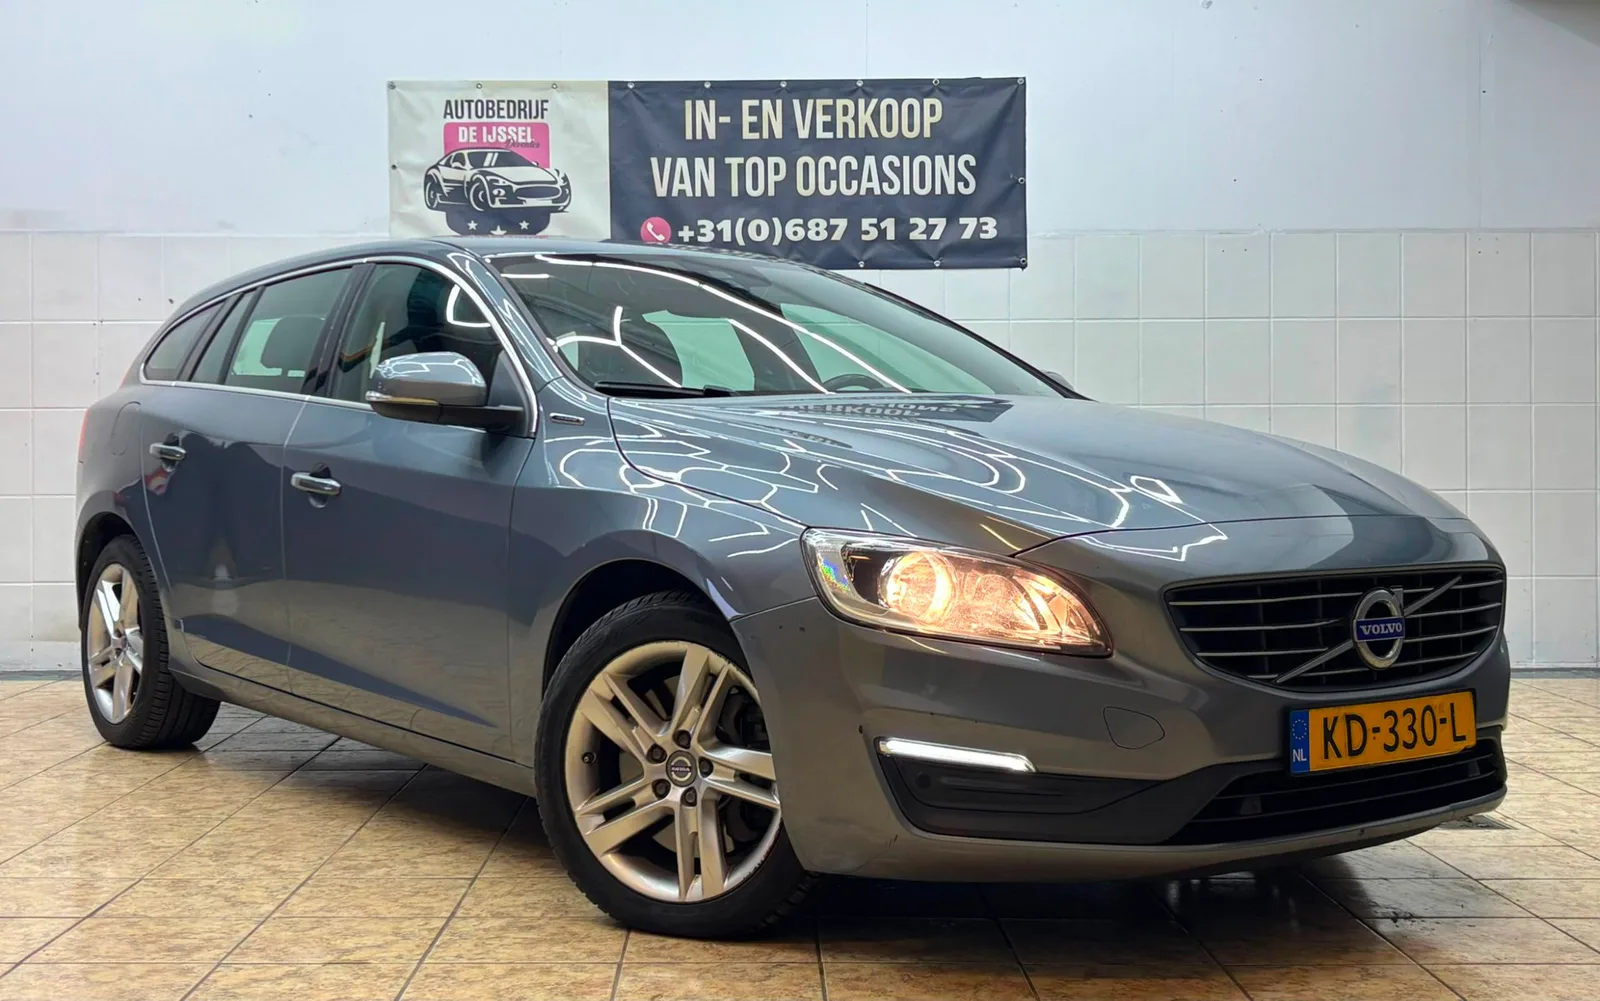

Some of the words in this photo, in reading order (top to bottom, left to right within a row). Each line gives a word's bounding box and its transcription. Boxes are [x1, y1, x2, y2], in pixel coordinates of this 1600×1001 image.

[443, 99, 549, 120] AUTOBEDRIJF
[684, 99, 731, 140] IN-
[742, 98, 783, 140] EN
[792, 97, 943, 139] VERKOOP
[458, 126, 478, 143] DE
[481, 125, 533, 143] IJSSEL
[650, 156, 715, 198] VAN
[724, 155, 787, 197] TOP
[795, 153, 977, 196] OCCASIONS
[678, 217, 848, 246] +31(0)687
[861, 217, 896, 241] 51
[908, 217, 949, 241] 27
[959, 216, 998, 240] 73
[1359, 623, 1403, 636] VOLVO
[1322, 702, 1467, 760] KD-330-L
[1292, 748, 1308, 762] NL
